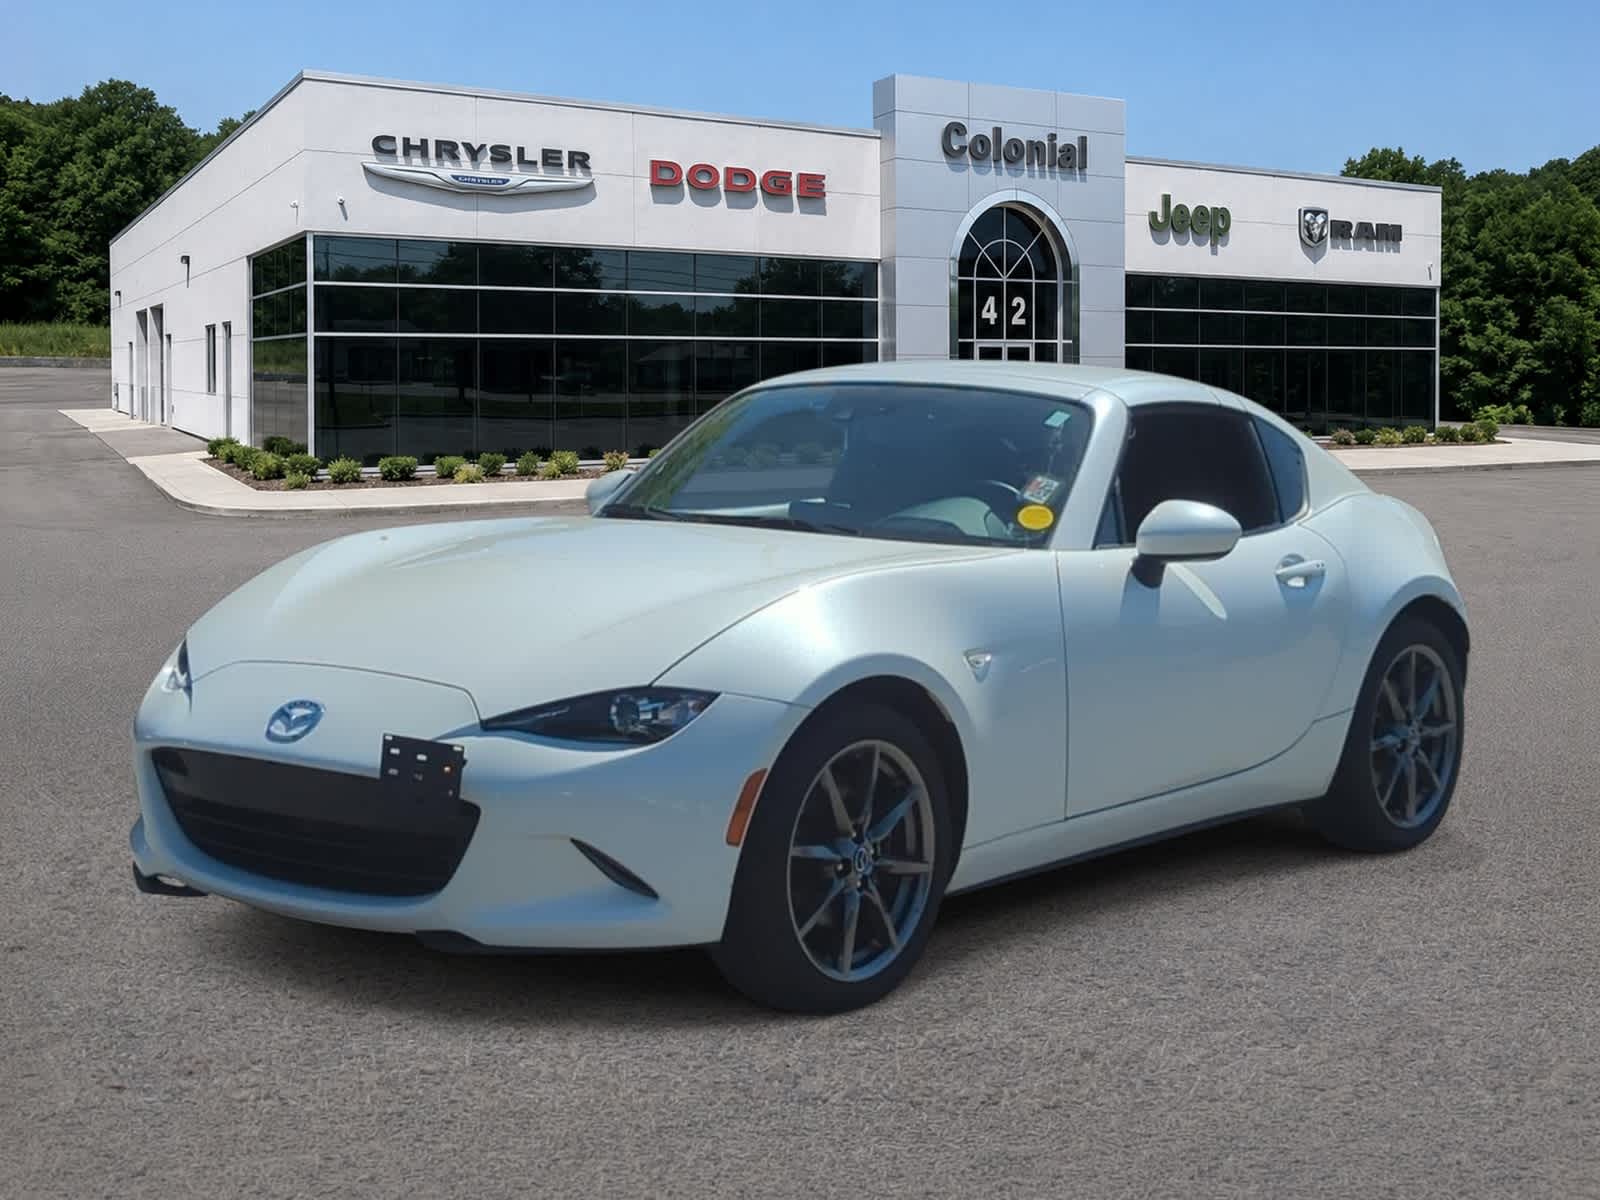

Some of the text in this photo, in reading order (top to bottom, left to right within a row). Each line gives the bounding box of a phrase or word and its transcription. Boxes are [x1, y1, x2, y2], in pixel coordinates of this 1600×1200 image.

[371, 134, 592, 169] CHRYSLER
[942, 121, 1088, 170] Colonial
[650, 159, 826, 198] DODGE
[1149, 194, 1231, 246] Jeep
[1330, 220, 1402, 242] RAM
